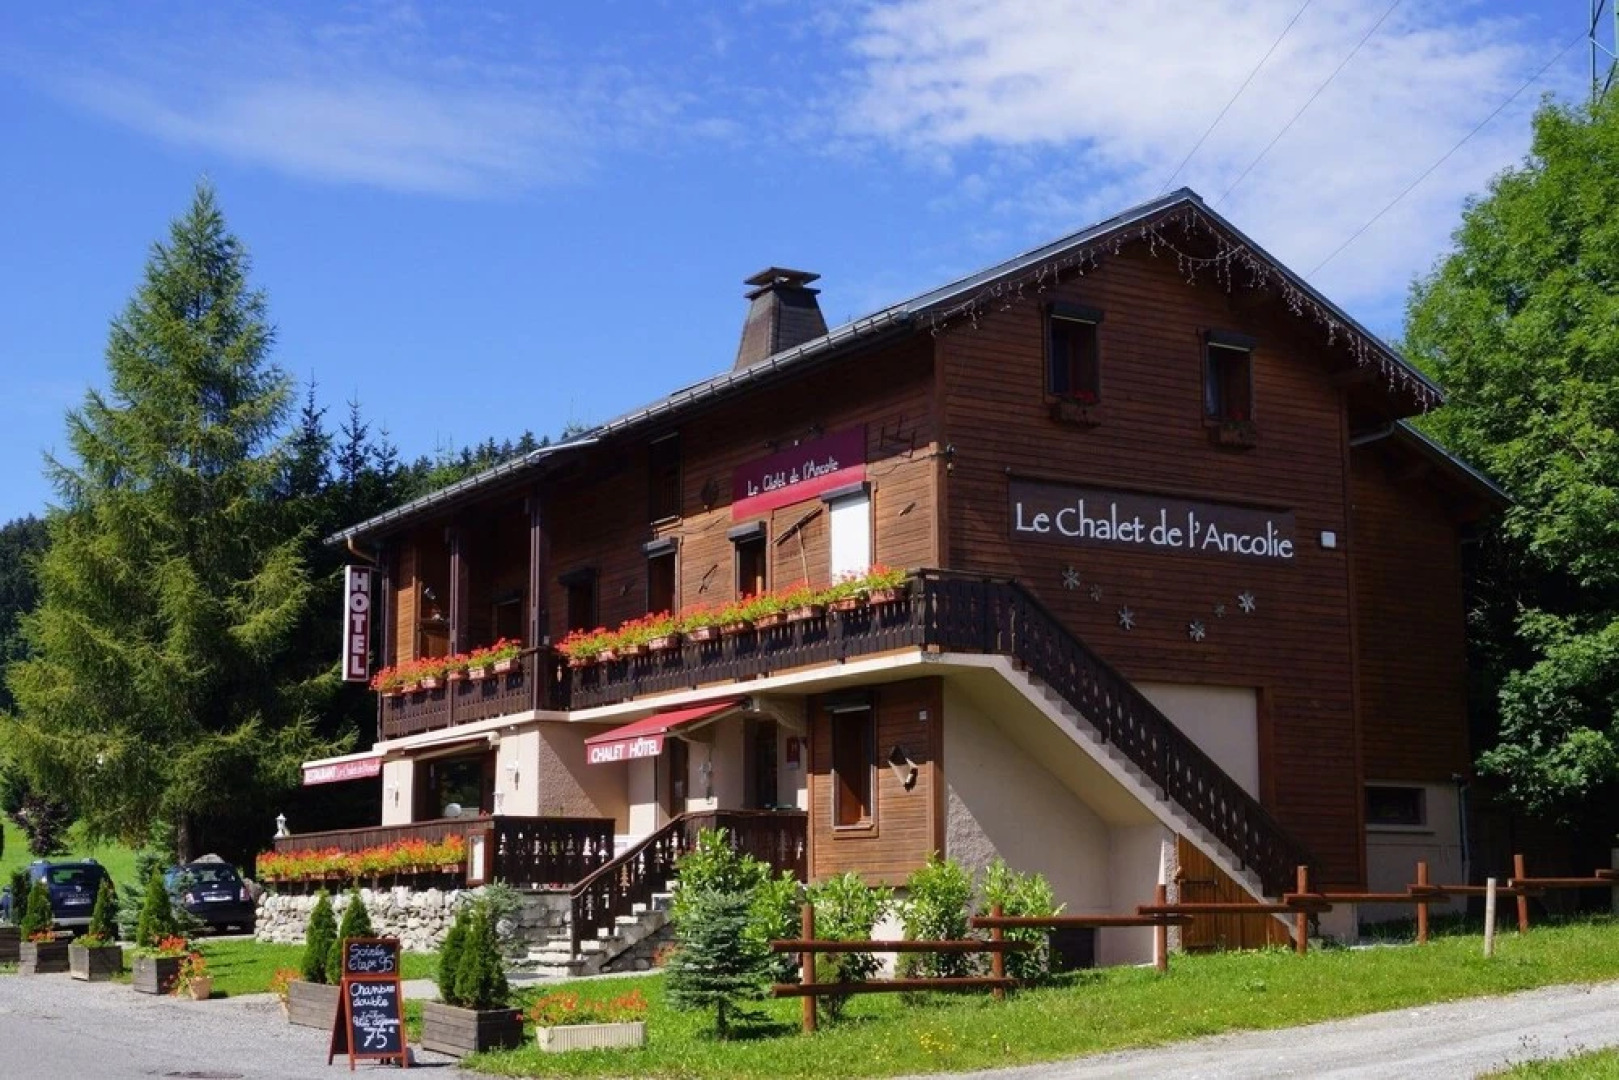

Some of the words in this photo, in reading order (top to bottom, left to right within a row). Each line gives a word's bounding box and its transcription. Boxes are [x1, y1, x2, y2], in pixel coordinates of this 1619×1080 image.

[747, 480, 758, 496] Le
[1015, 502, 1050, 533] Le
[1055, 498, 1146, 543] Chalet
[1149, 508, 1183, 548] de
[1187, 511, 1294, 559] l'Ancolie
[350, 571, 370, 675] HOTEL
[591, 744, 626, 763] CHALET
[629, 737, 660, 758] HÔTEL
[353, 995, 389, 1007] double
